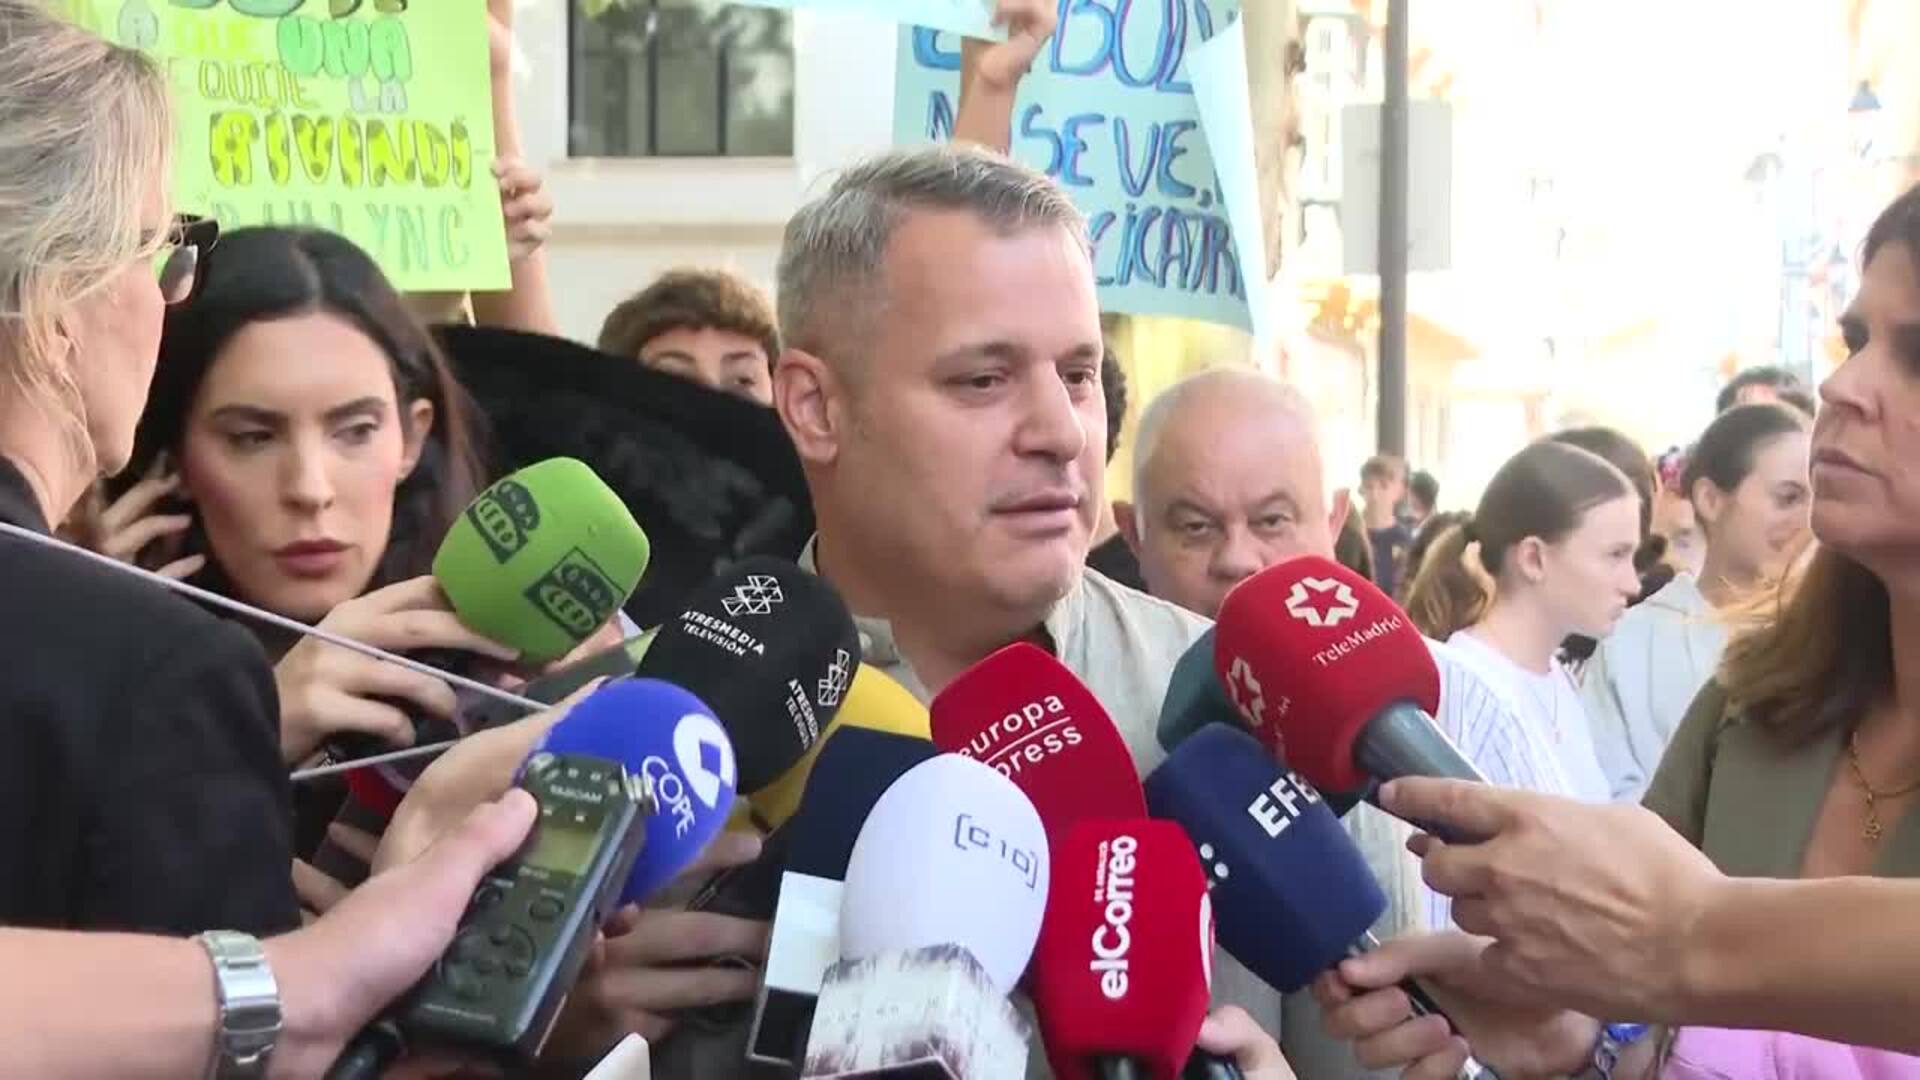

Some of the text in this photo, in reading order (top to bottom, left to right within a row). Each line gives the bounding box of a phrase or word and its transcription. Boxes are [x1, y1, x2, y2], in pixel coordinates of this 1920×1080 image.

[276, 15, 413, 82] UNA
[1021, 102, 1105, 187] SE
[679, 610, 765, 656] ATRESMEDIA
[1312, 614, 1402, 667] TeleMadrid
[1247, 772, 1322, 839] EFE
